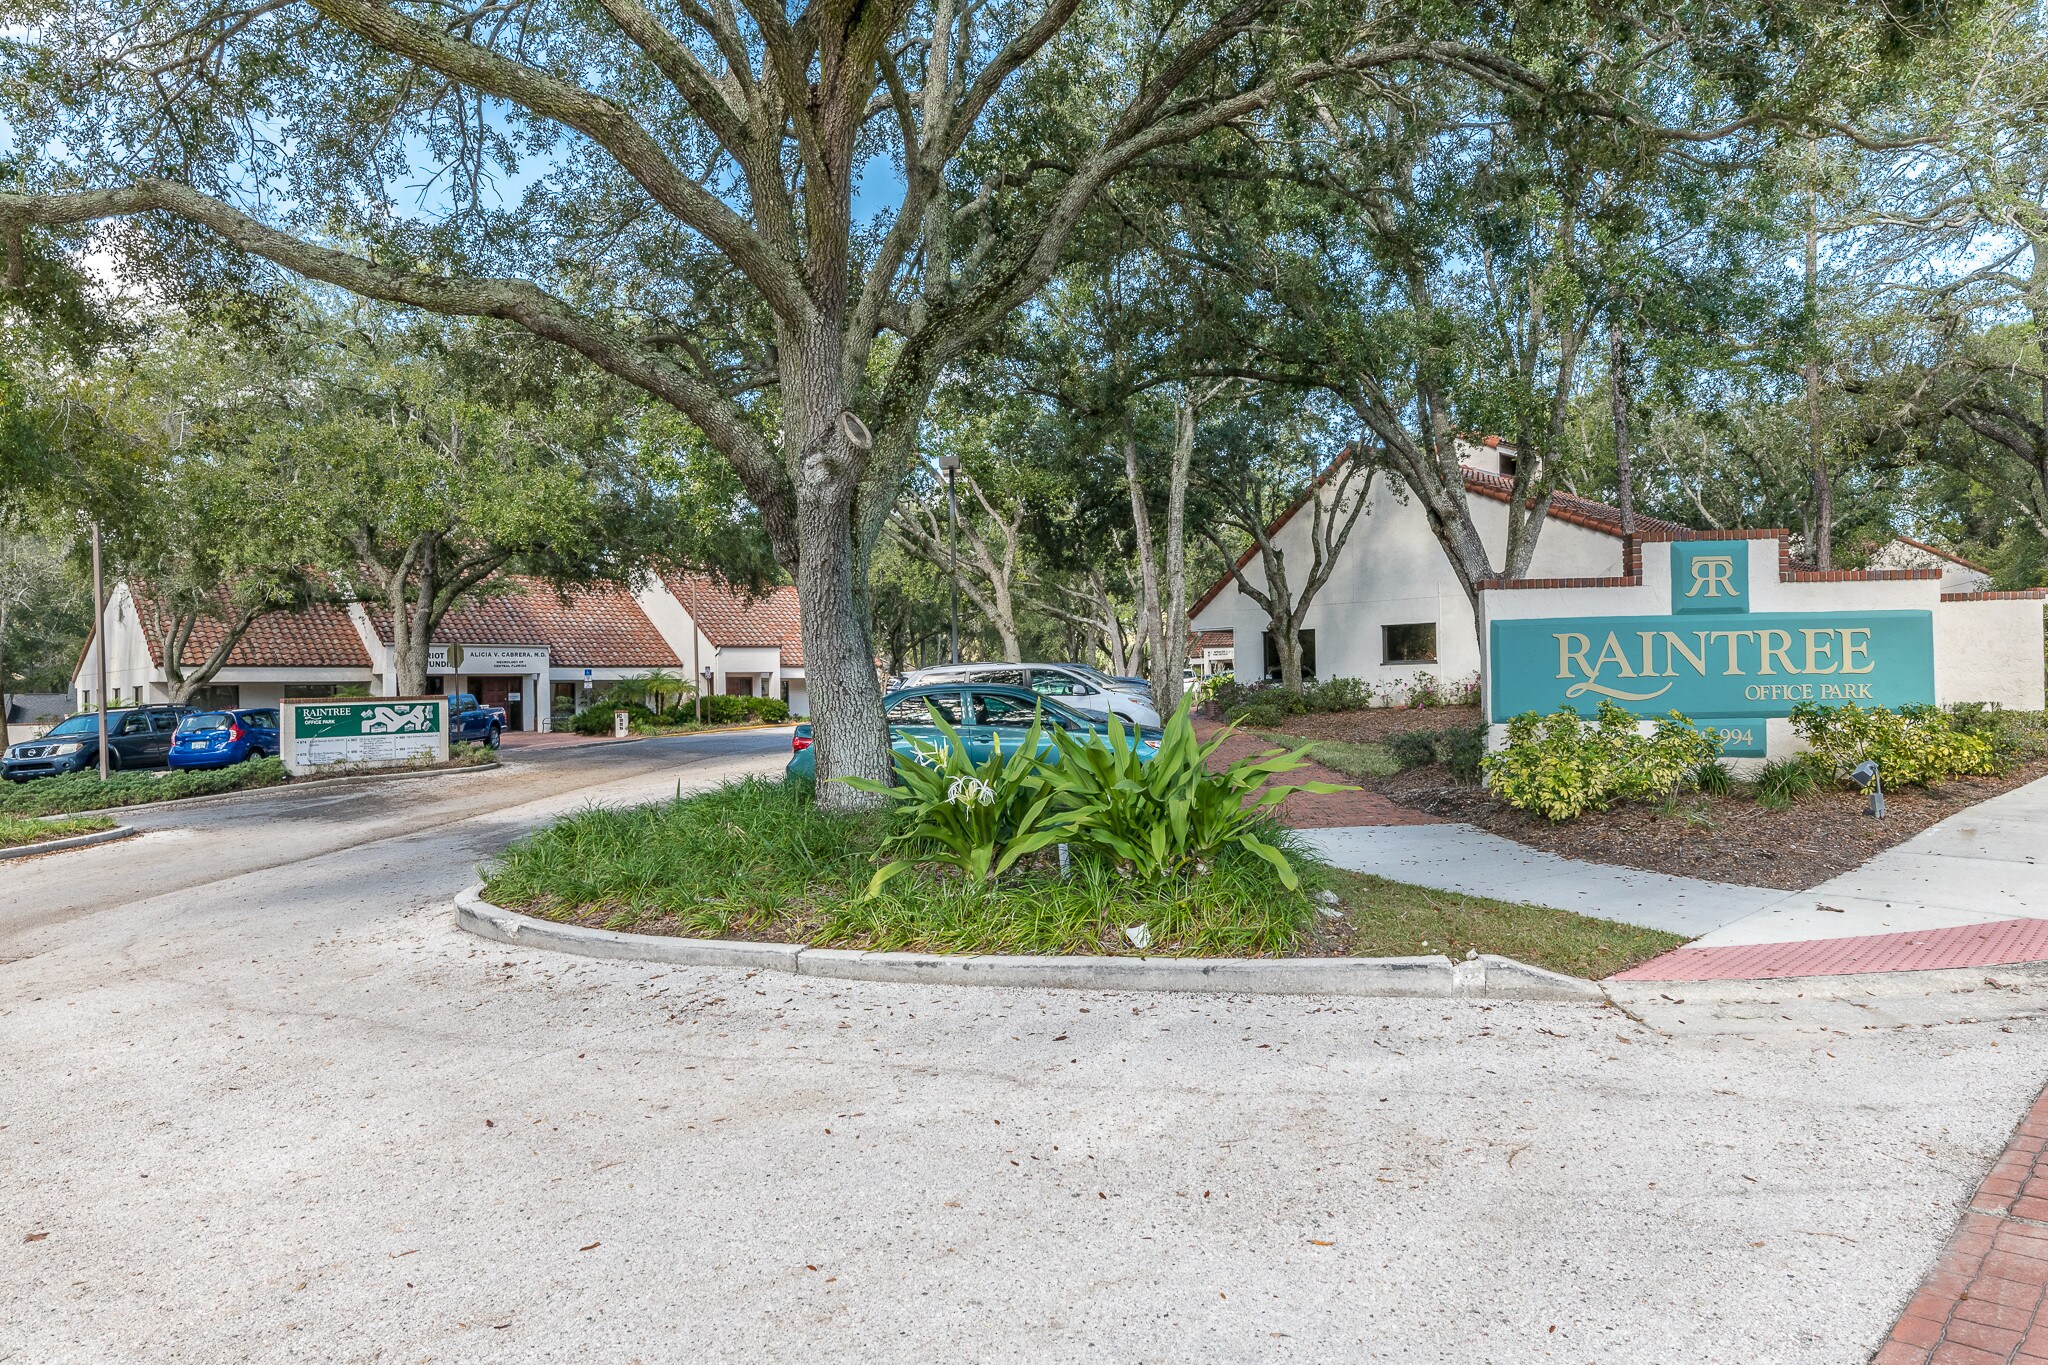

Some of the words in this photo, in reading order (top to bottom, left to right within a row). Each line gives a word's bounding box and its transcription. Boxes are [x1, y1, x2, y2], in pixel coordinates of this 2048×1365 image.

[1552, 627, 1876, 701] RAINTREE
[1744, 684, 1814, 702] OFFICE
[1821, 683, 1874, 700] PARK
[303, 708, 351, 720] RAINTREE
[1720, 728, 1754, 746] 994
